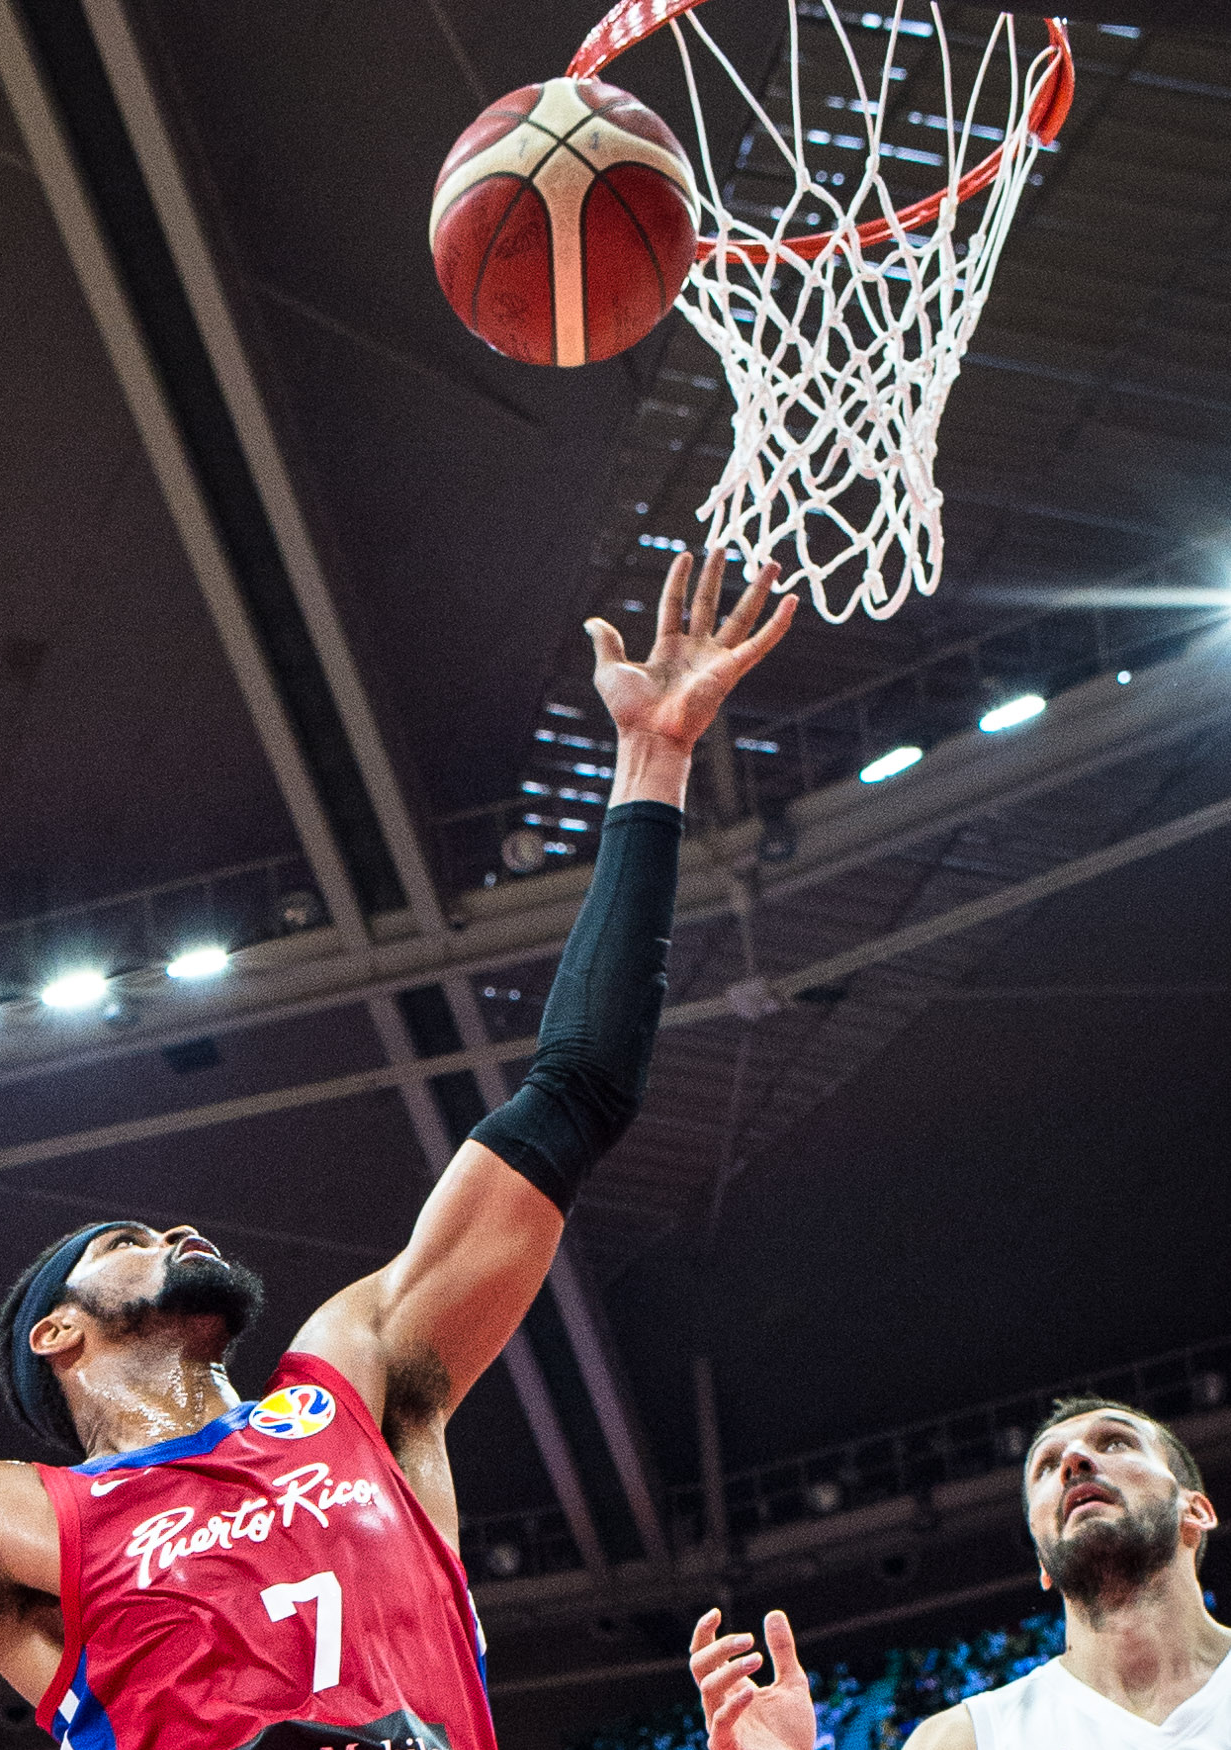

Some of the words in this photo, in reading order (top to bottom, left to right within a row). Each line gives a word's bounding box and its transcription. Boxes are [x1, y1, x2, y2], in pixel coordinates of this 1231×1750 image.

[125, 1498, 275, 1590] Puerto
[272, 1462, 379, 1529] Rico
[260, 1571, 343, 1694] 7
